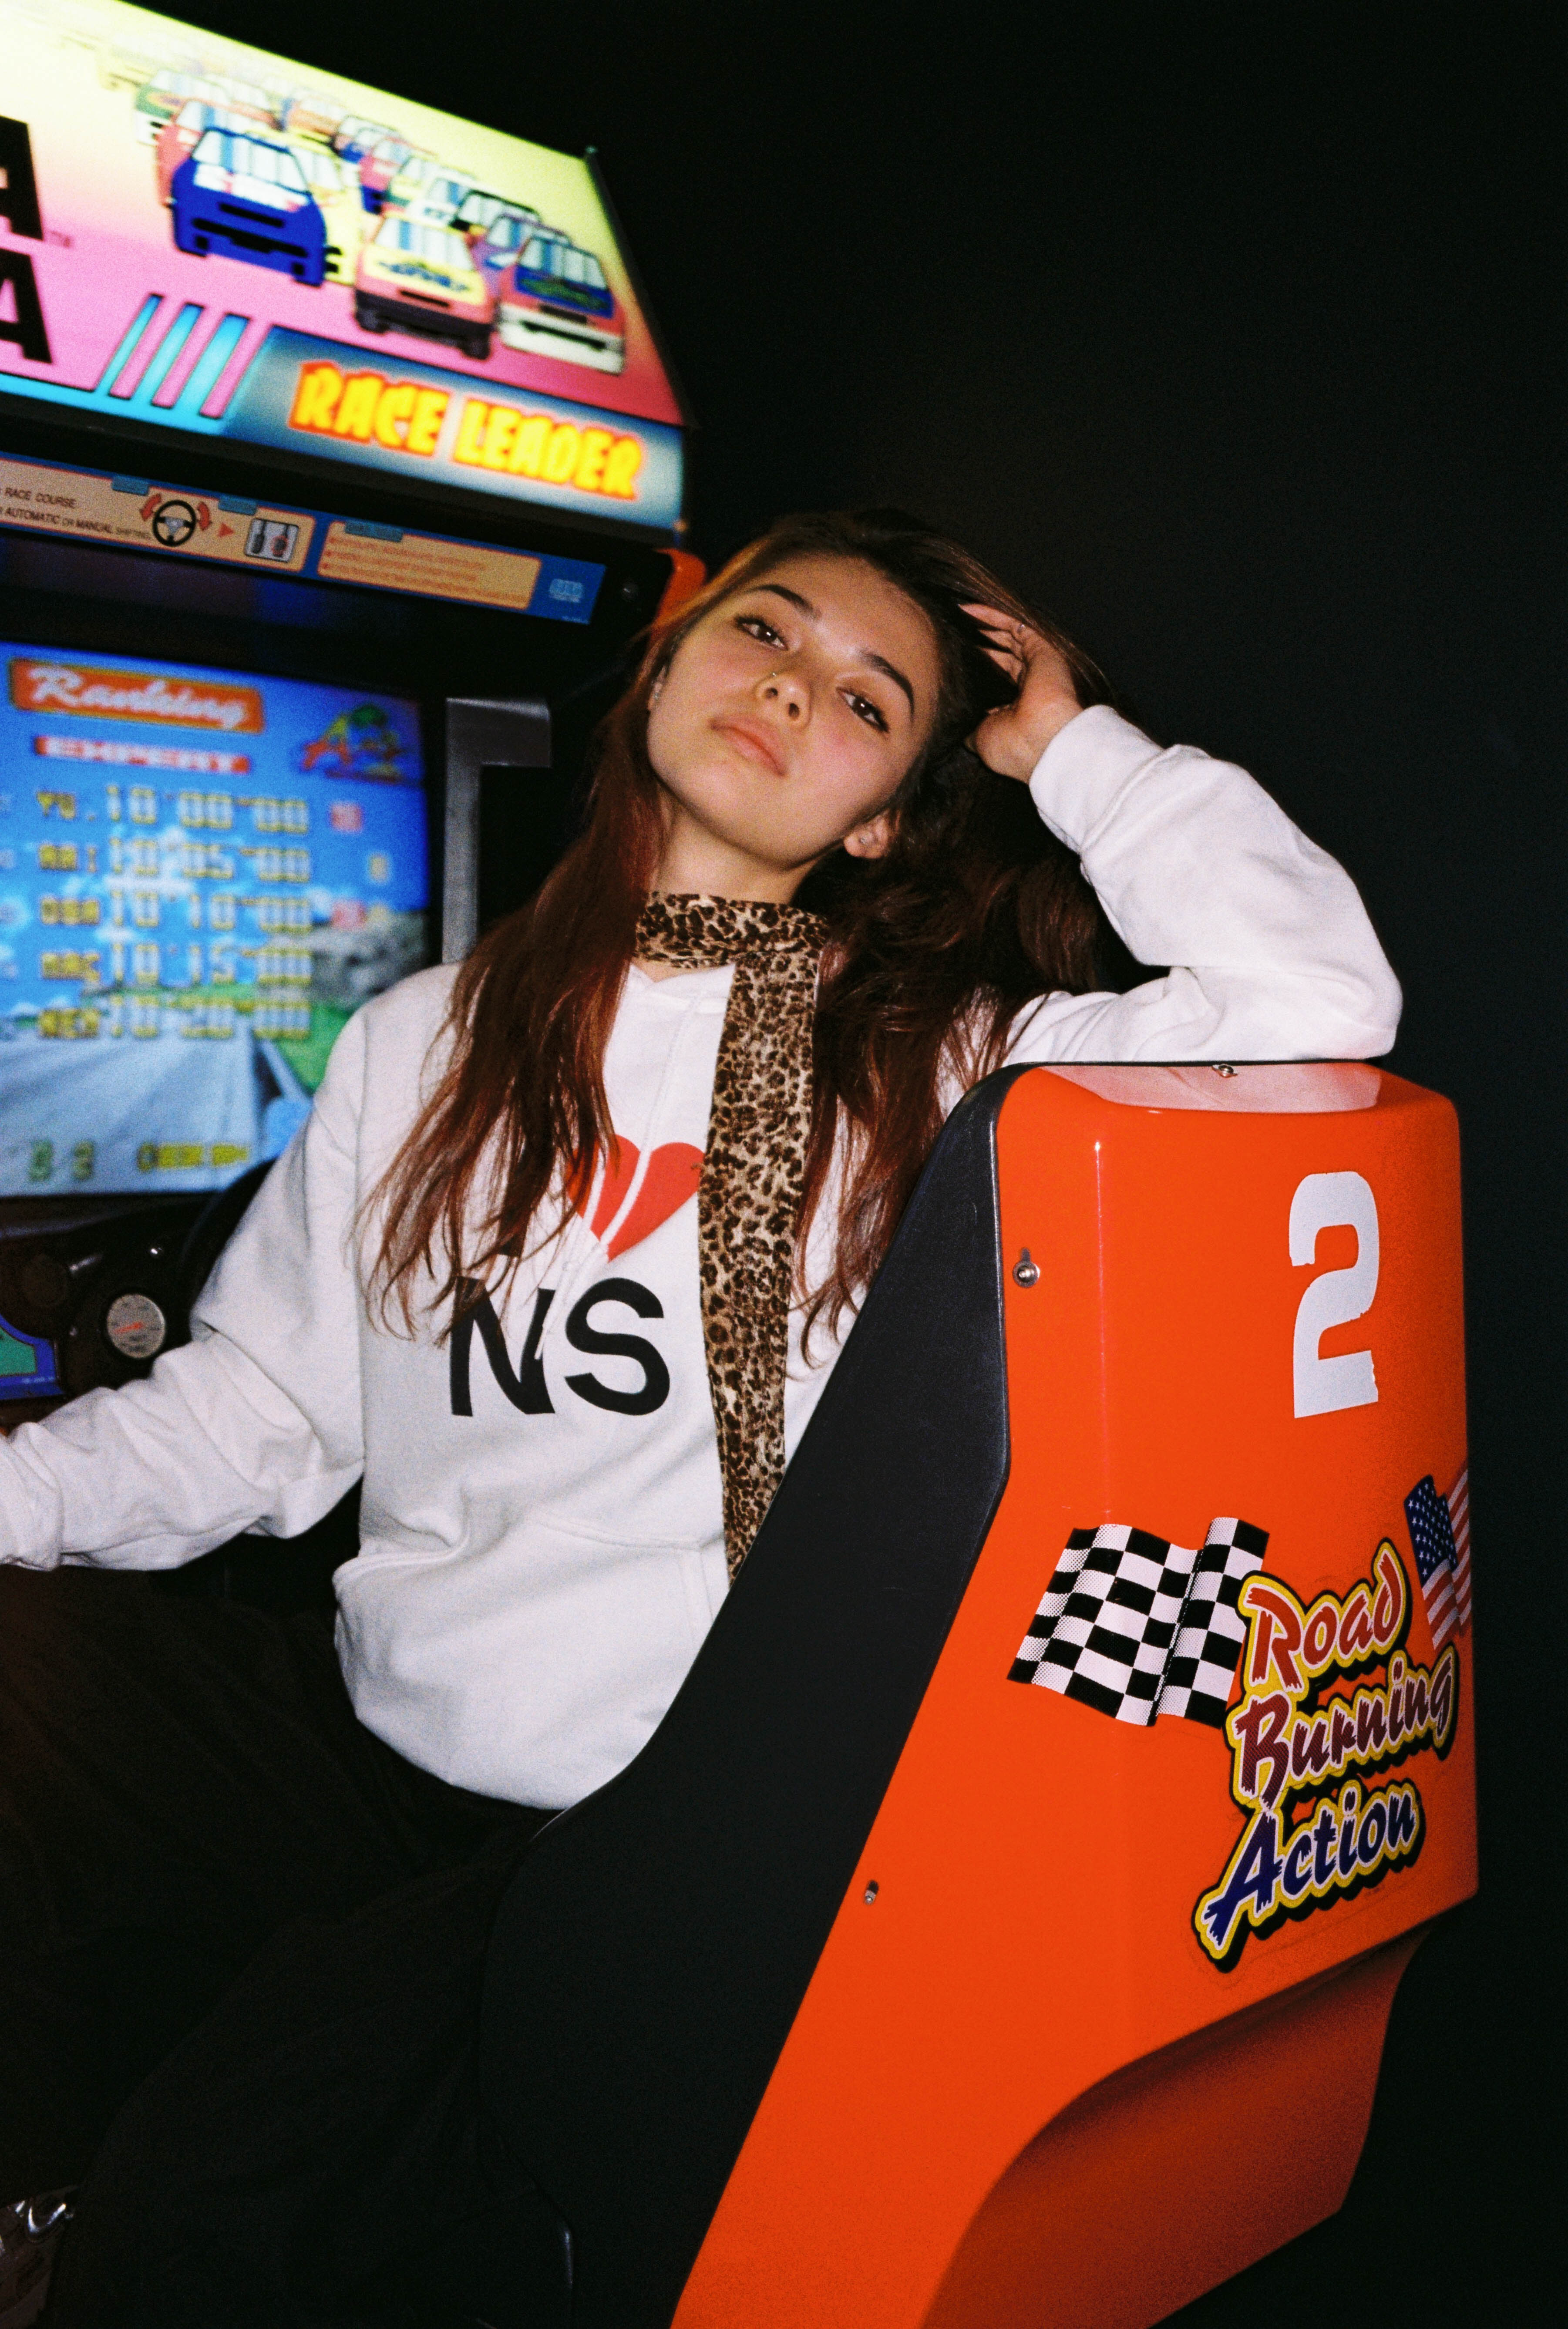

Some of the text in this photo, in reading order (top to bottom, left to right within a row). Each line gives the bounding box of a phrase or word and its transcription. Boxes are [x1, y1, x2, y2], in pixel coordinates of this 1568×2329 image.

[4, 487, 76, 509] RACE COURSE
[288, 360, 644, 502] RACE LEADER
[5, 507, 60, 524] AUTOMATIC
[76, 519, 113, 534] MANUAL
[26, 664, 247, 730] Ranking
[449, 1276, 671, 1417] NS
[1289, 1171, 1379, 1418] 2
[1242, 1548, 1406, 1693] Road
[1231, 1652, 1454, 1812] Burning
[1200, 1786, 1417, 1950] Action
